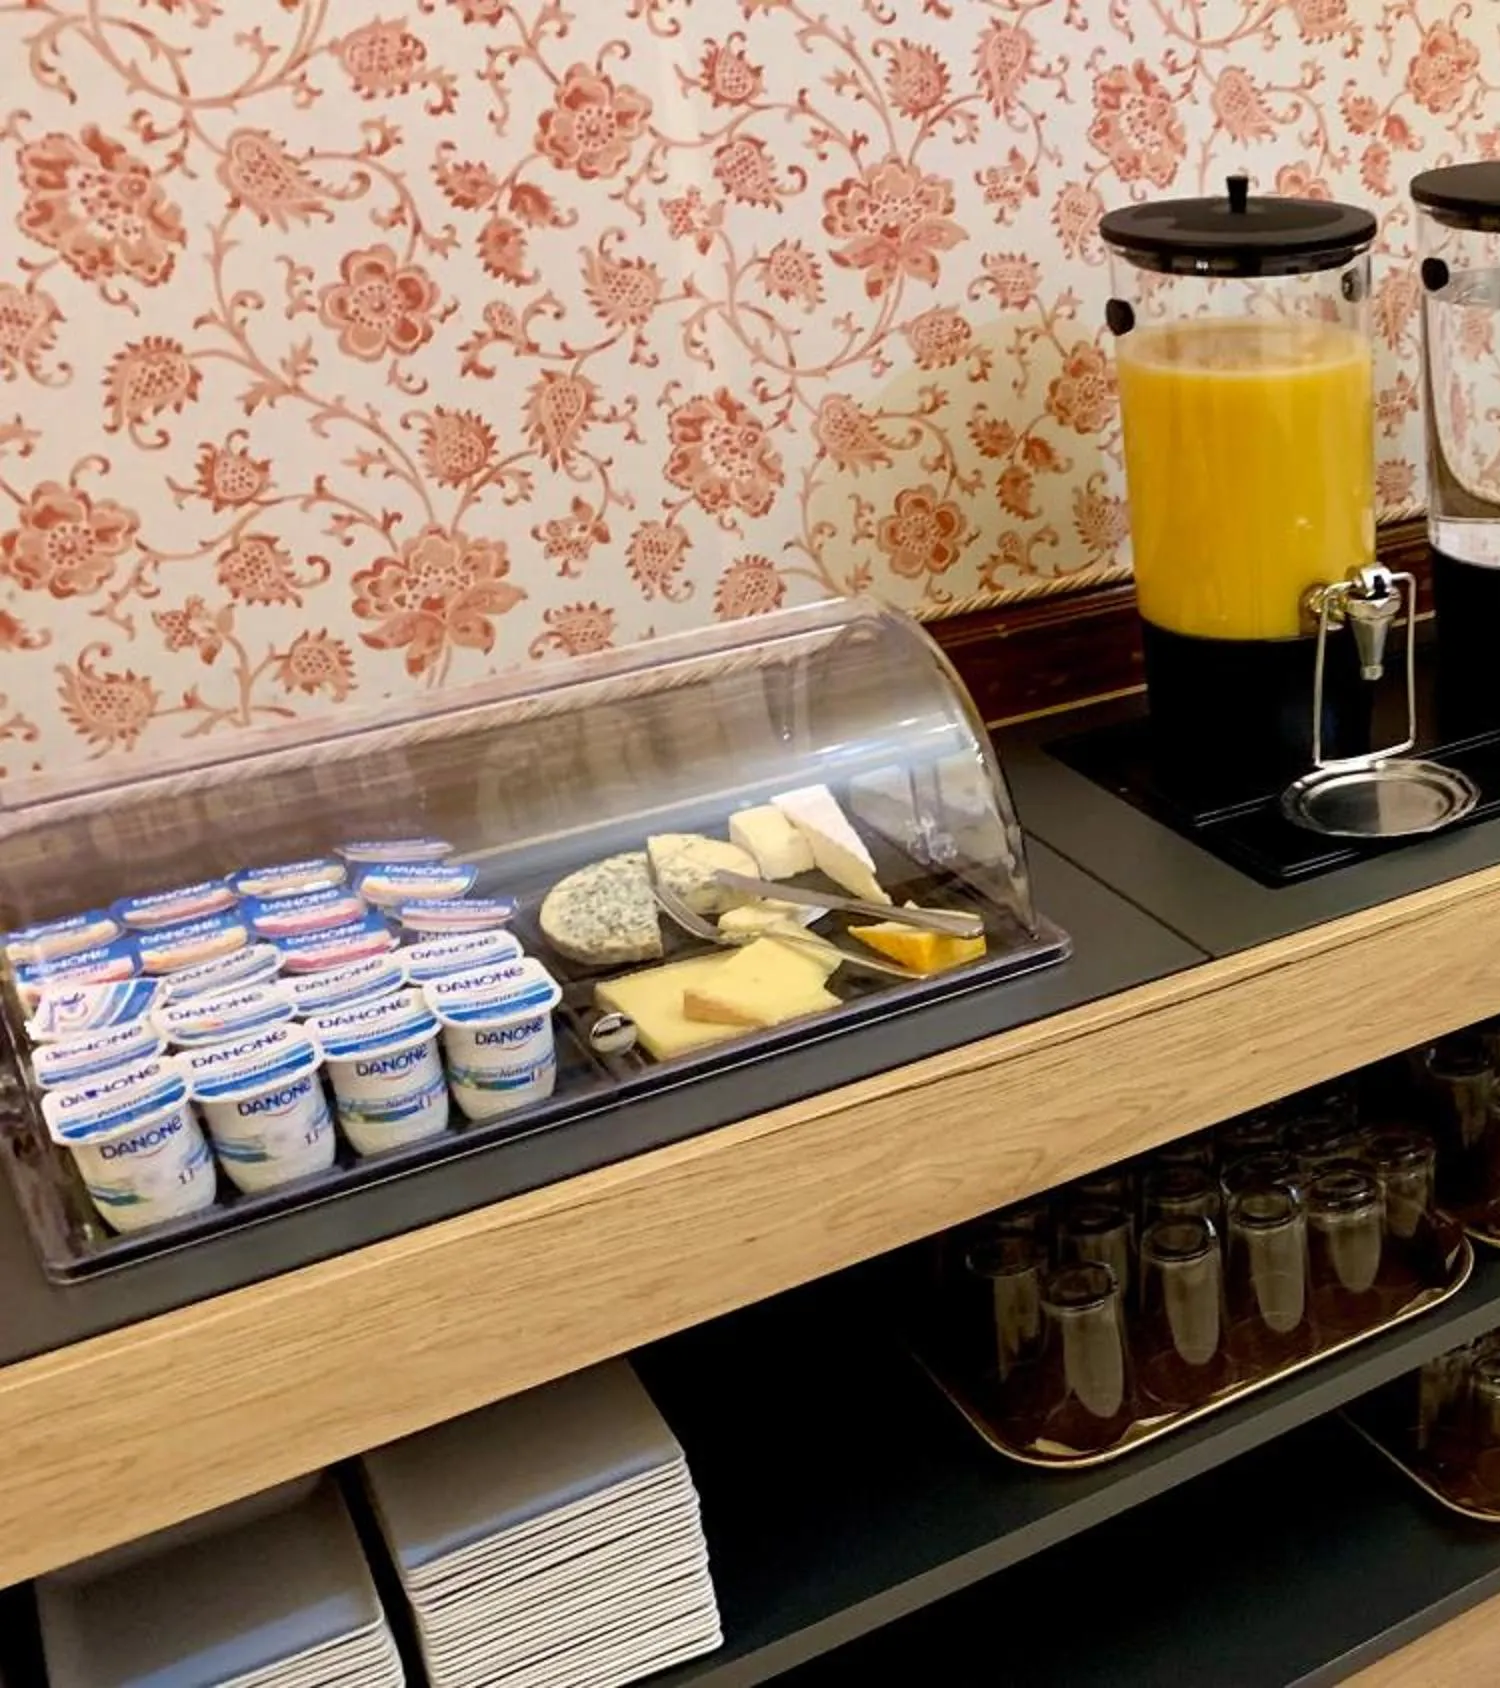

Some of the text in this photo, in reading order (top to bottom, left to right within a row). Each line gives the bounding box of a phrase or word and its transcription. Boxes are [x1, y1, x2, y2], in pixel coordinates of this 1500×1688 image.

[436, 967, 525, 993] DANONE
[317, 998, 410, 1029] DANONE
[475, 1016, 544, 1045] DANONE
[191, 1029, 288, 1068] DANONE
[355, 1043, 429, 1077] DANONE
[238, 1076, 312, 1116] DANONE
[101, 1114, 183, 1159] DANONE
